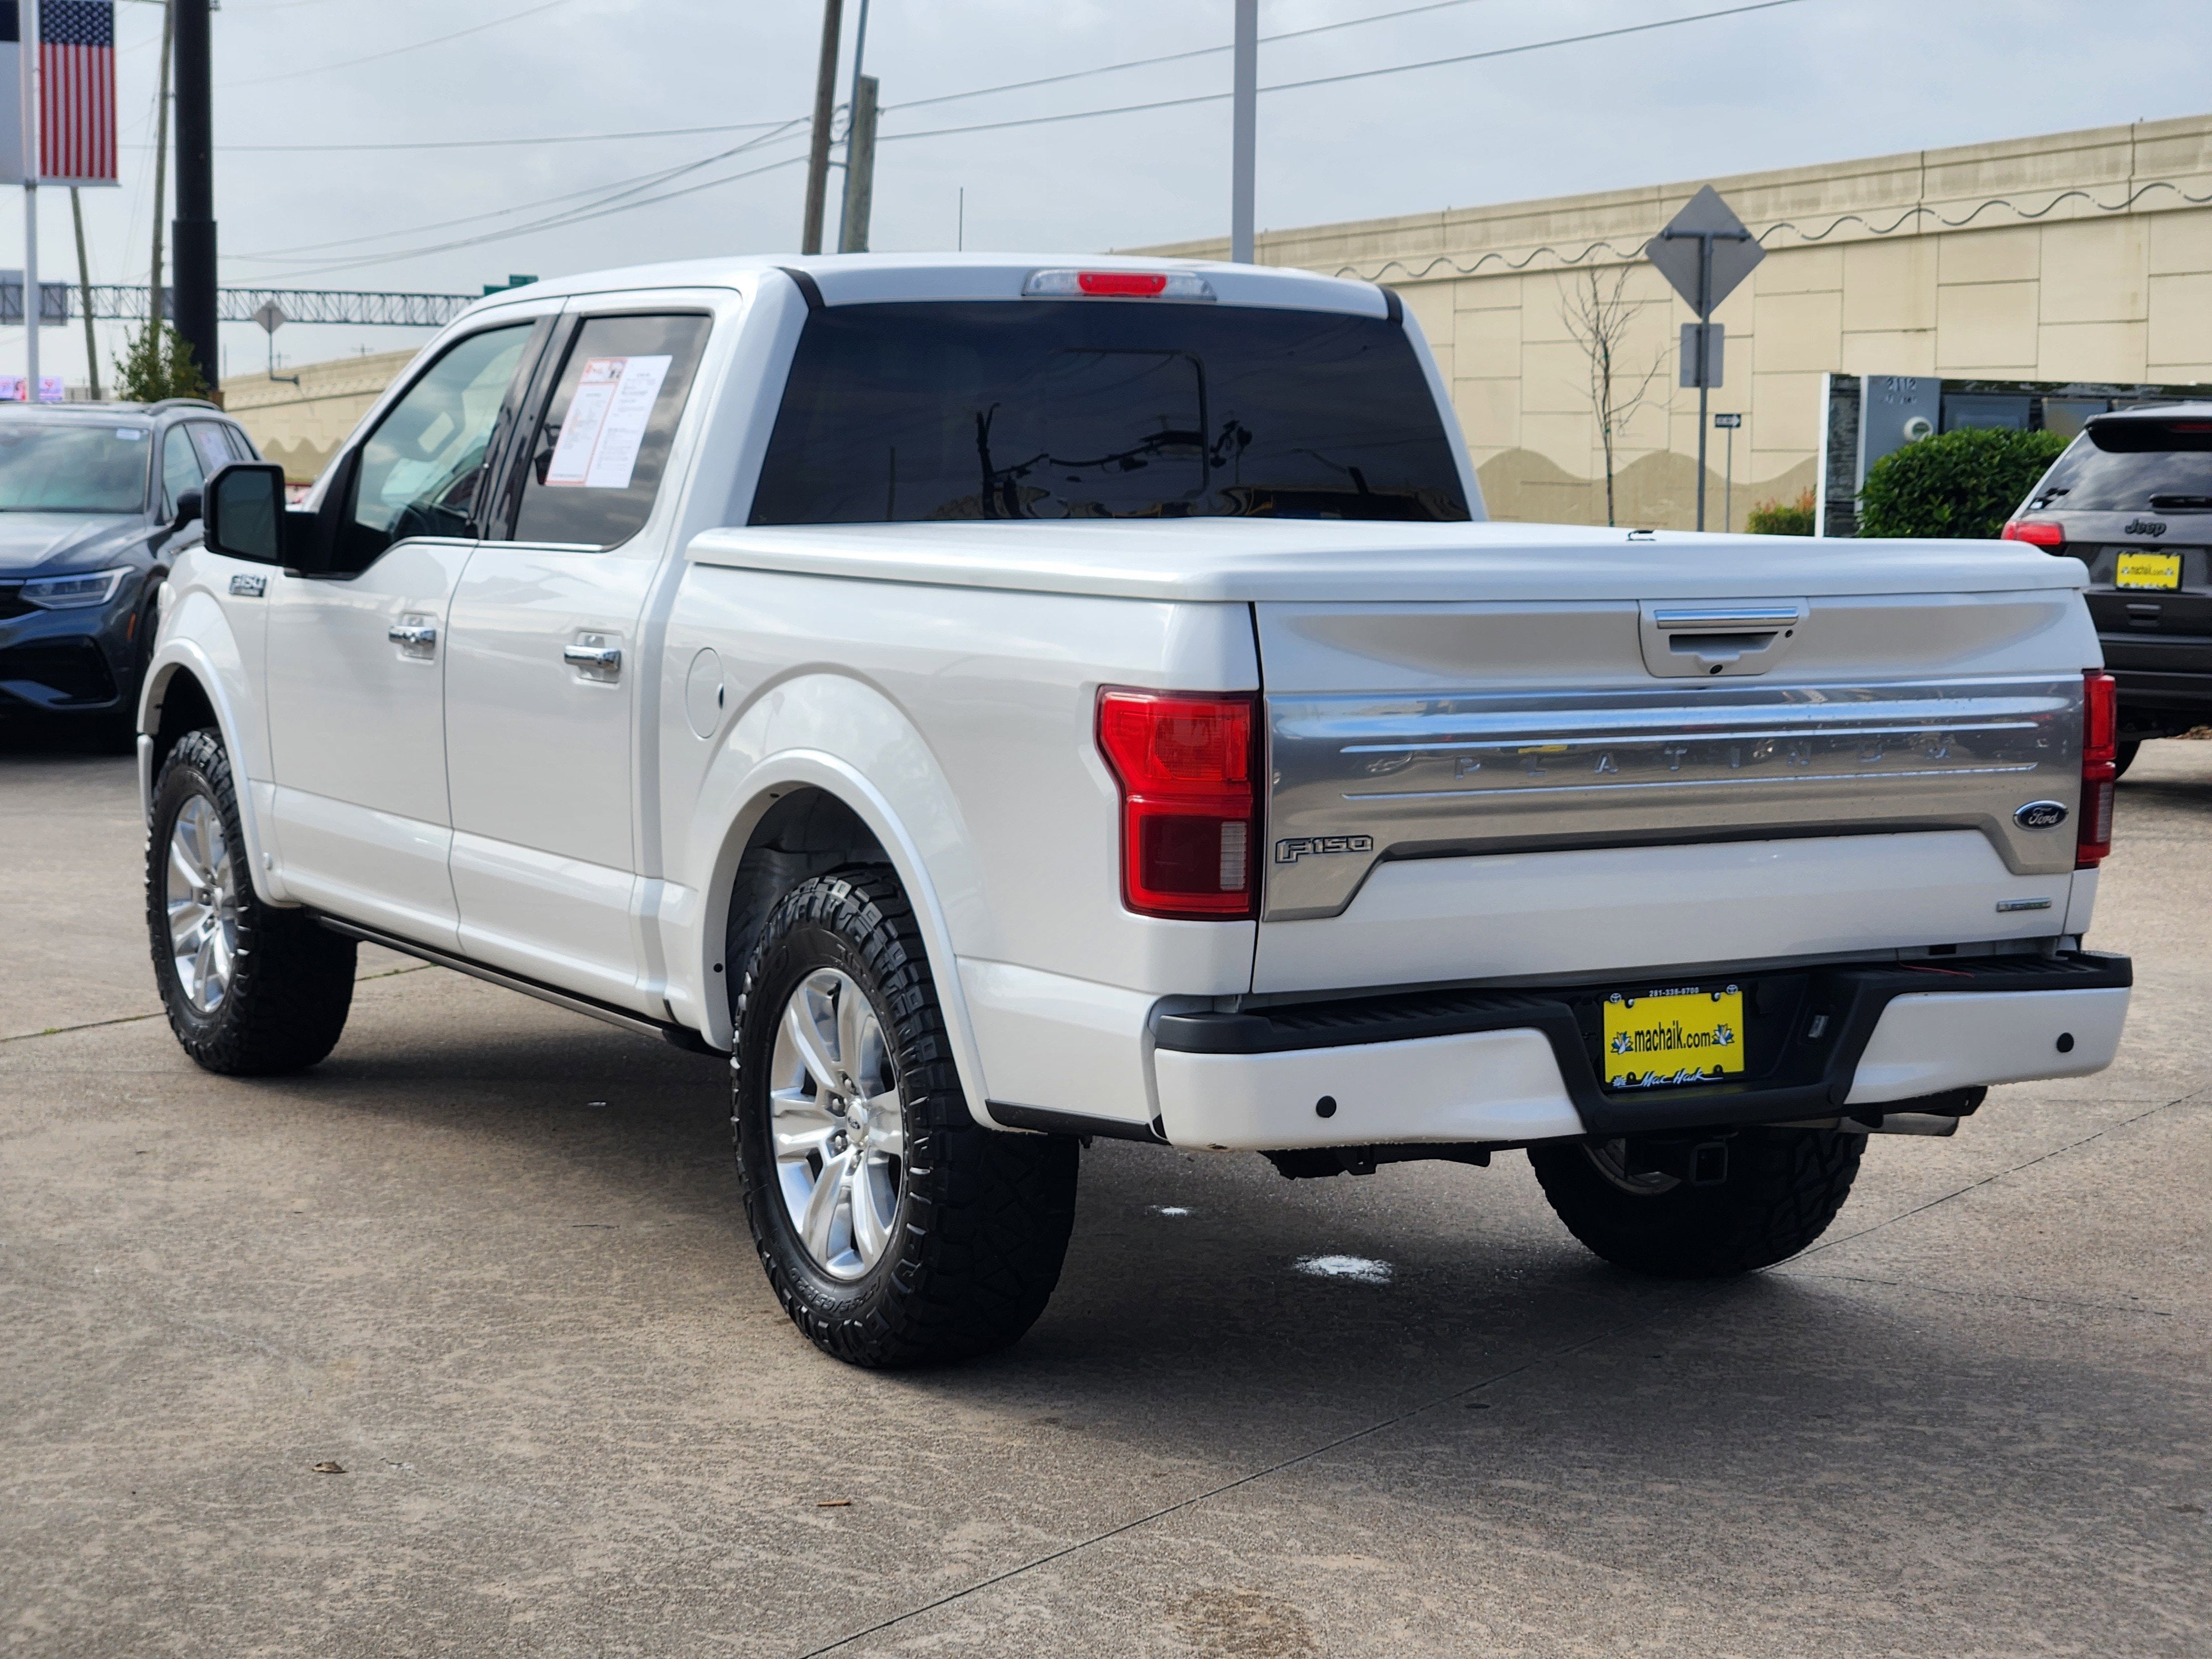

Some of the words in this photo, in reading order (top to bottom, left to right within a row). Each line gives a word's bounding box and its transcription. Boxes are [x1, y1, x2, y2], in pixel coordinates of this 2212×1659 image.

[2125, 518, 2166, 538] Jeep
[2028, 807, 2059, 825] Ford
[1634, 1020, 1711, 1052] machaik.com
[1639, 1070, 1672, 1087] Mac
[1672, 1067, 1707, 1085] Haik
